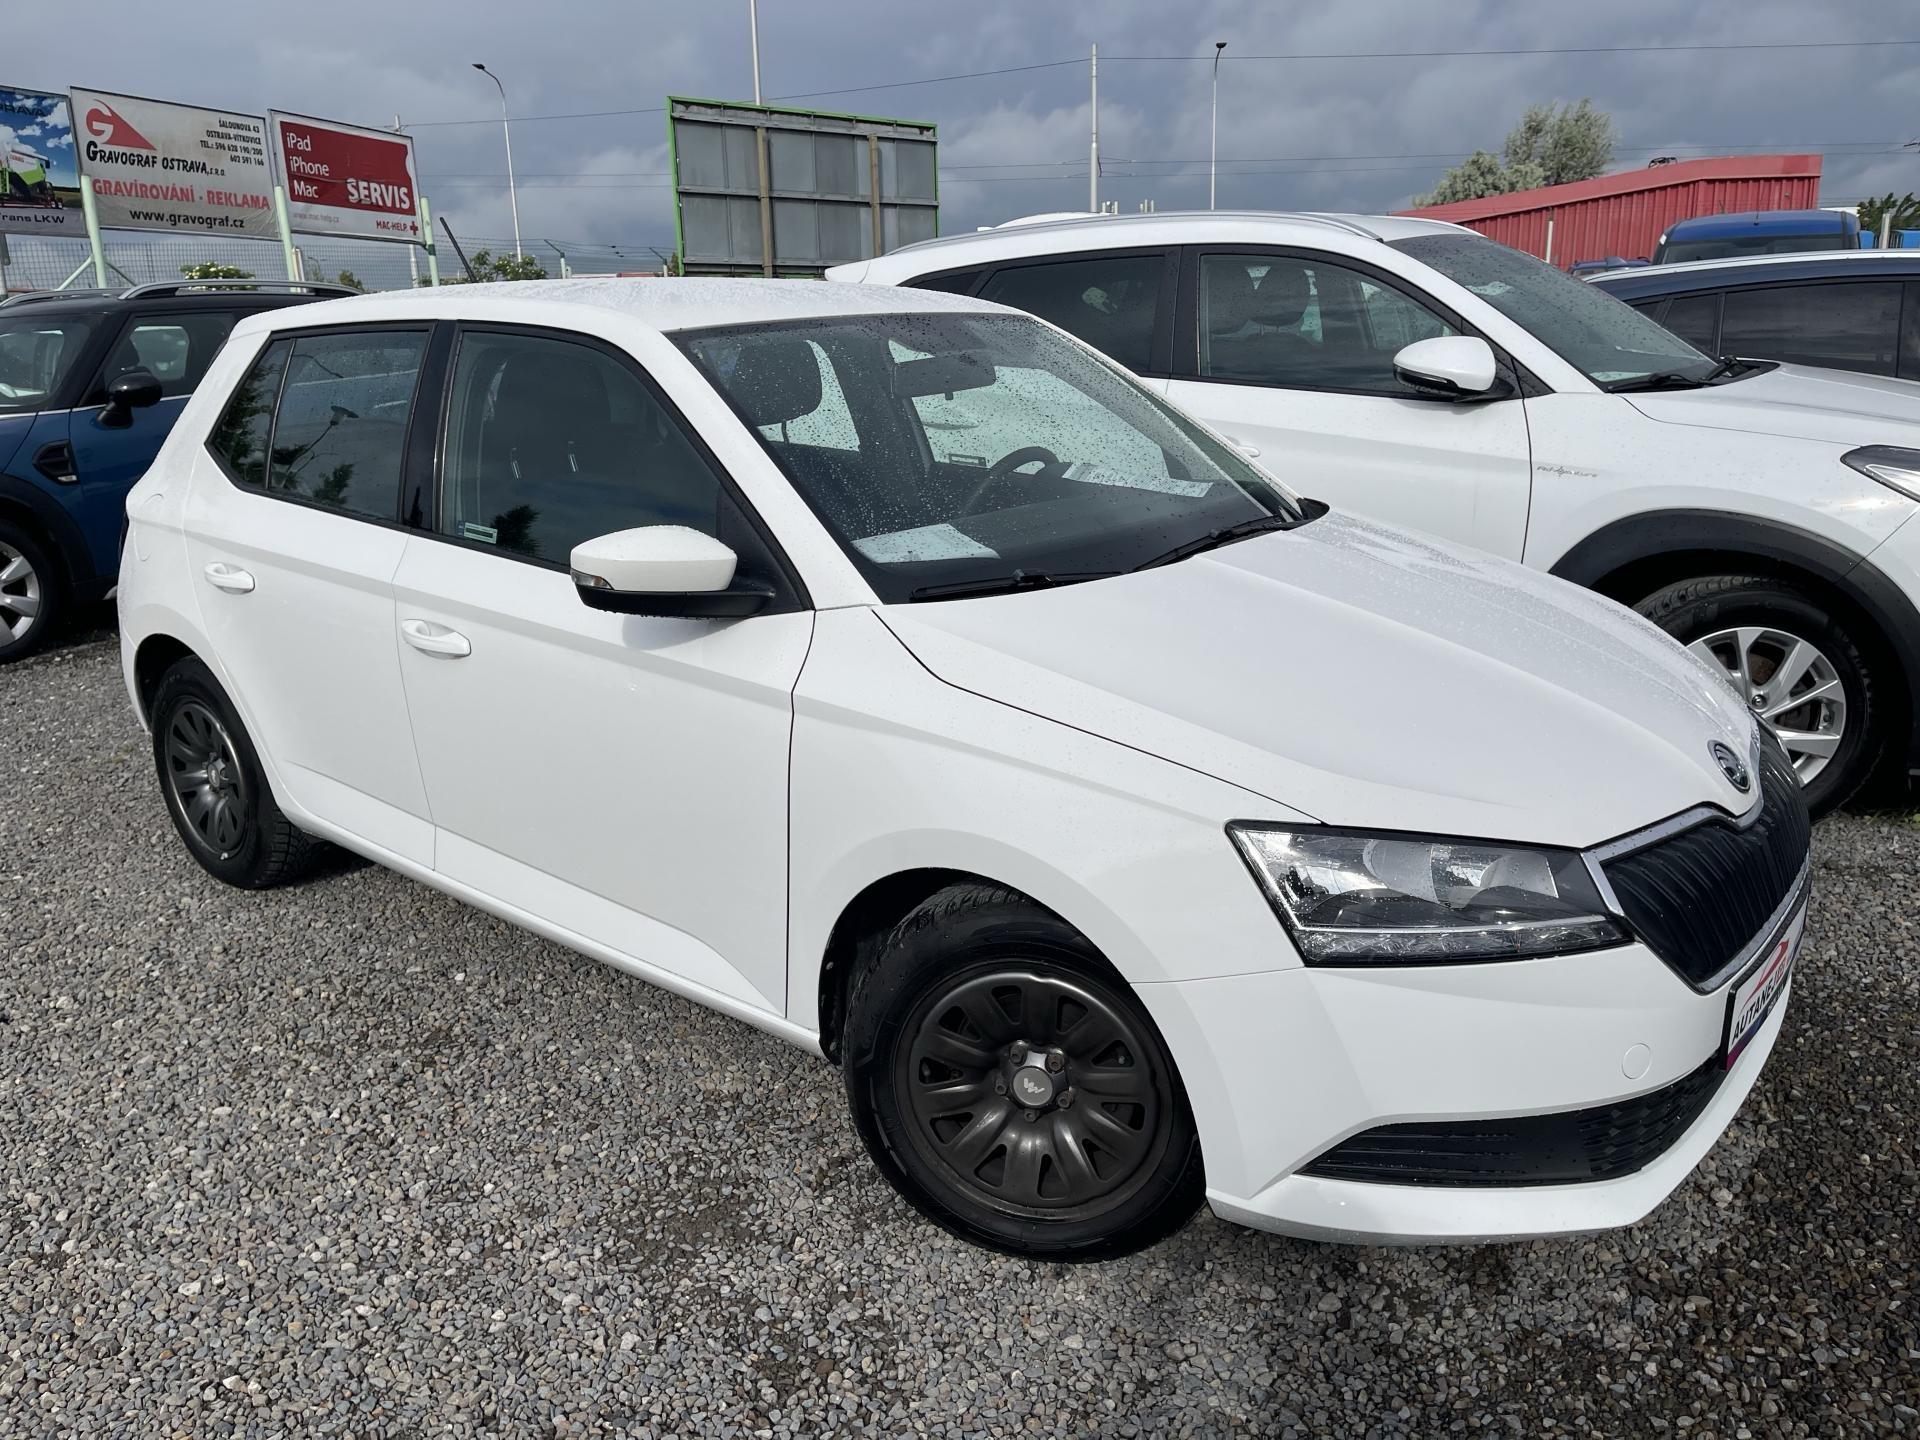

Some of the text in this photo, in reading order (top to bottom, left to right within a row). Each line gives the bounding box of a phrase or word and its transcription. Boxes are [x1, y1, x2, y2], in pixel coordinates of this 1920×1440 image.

[286, 132, 312, 152] iPad
[86, 140, 158, 169] GRAVOGRAF
[289, 155, 330, 177] iPhone
[206, 189, 271, 211] REKLAMA
[293, 179, 319, 199] Mac
[346, 177, 411, 210] SERVIS
[0, 212, 65, 224] rans LKW
[129, 208, 245, 230] www.gravograf.cz
